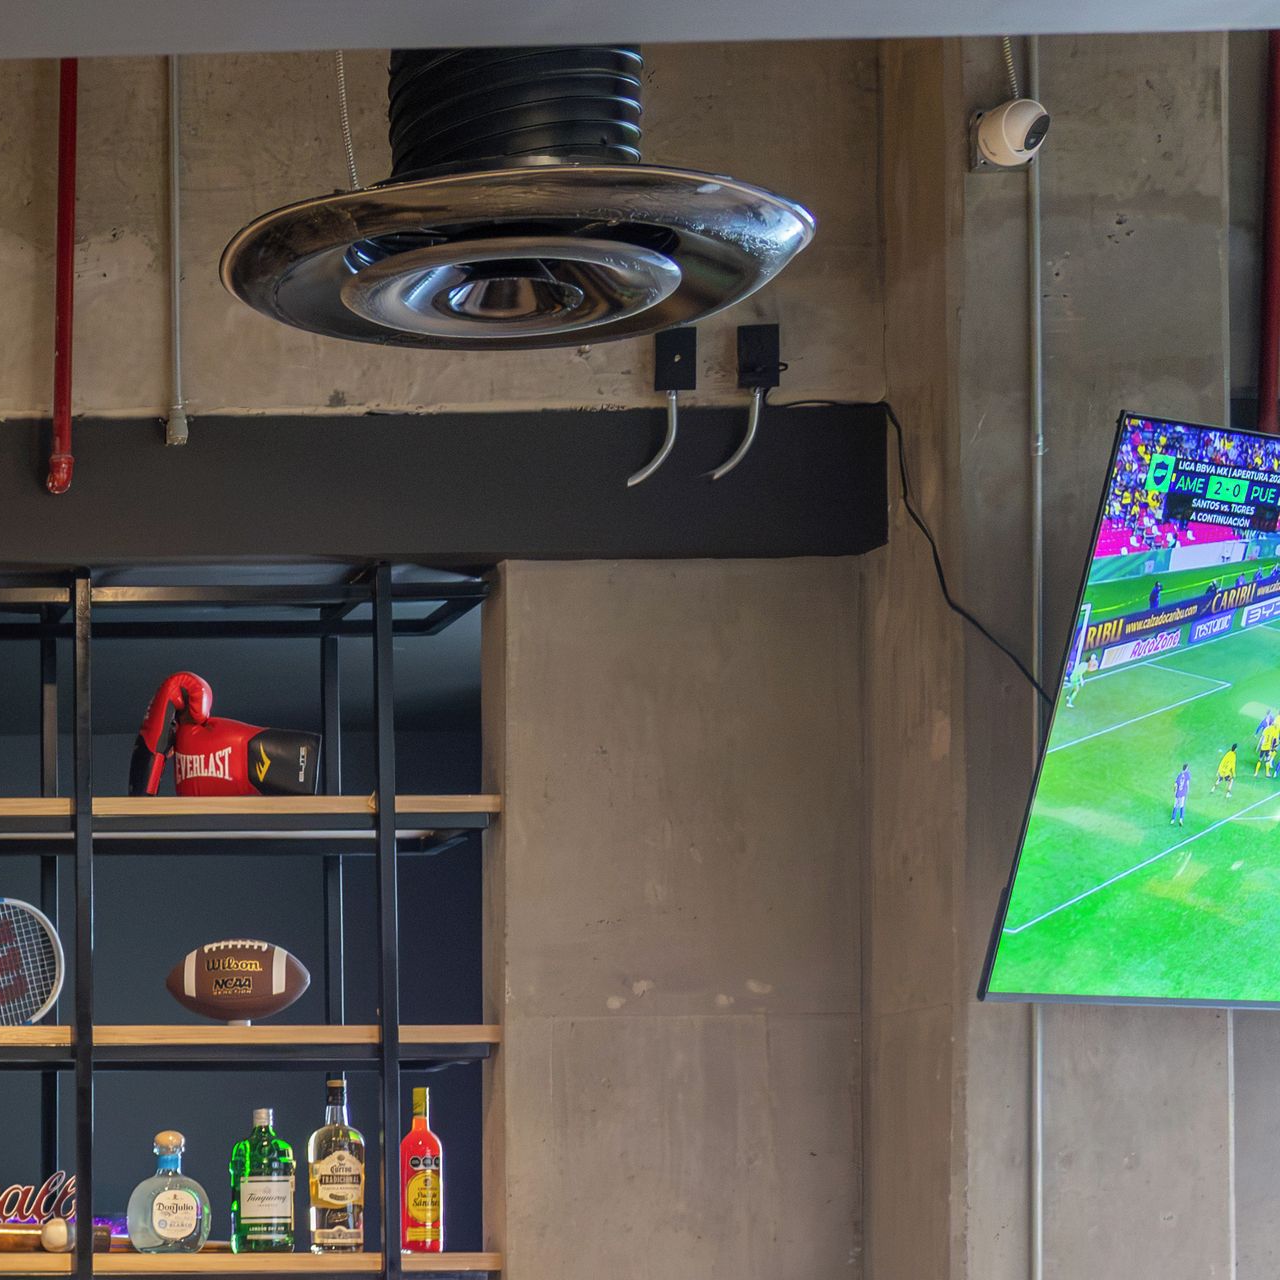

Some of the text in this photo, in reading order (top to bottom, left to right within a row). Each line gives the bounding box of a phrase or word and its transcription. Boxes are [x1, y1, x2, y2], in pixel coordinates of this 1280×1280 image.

[1178, 461, 1195, 471] LIGA
[1196, 464, 1215, 474] BBVA
[1216, 466, 1229, 476] MX
[1231, 468, 1269, 482] APERTURA
[1175, 475, 1206, 494] AME
[1214, 481, 1223, 495] 2
[1232, 483, 1241, 498] 0
[1250, 486, 1277, 503] PUE
[1192, 498, 1220, 511] SANTOS
[1231, 503, 1255, 515] TIGRES
[1197, 513, 1251, 528] CONTINUACIÓN
[1212, 582, 1256, 614] CARIBU
[1130, 629, 1181, 659] AutoZone
[175, 746, 233, 784] EVERLAST
[206, 956, 259, 972] Wilson
[213, 976, 253, 990] NCAA
